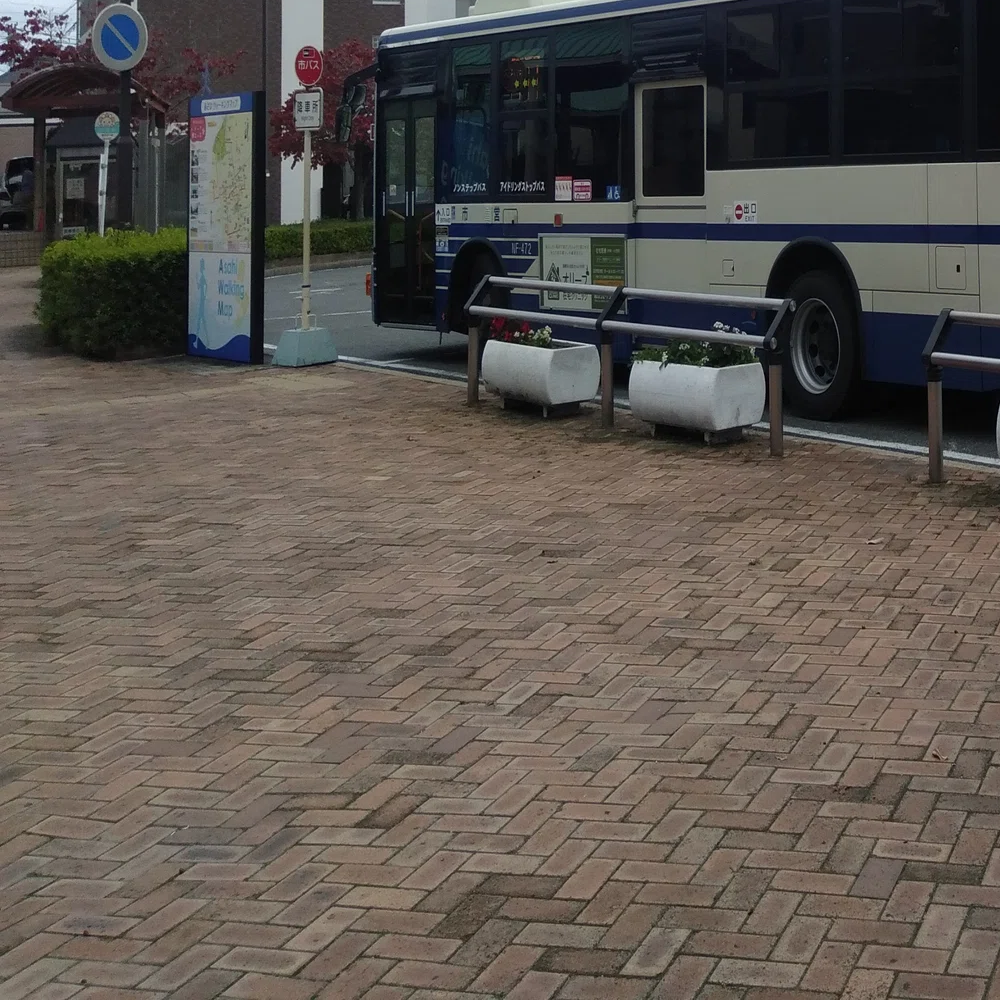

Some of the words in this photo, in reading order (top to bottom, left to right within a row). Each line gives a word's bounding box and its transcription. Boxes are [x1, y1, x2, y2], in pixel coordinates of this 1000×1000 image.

[298, 60, 319, 70] 市バス
[453, 182, 486, 192] ノンステップバス
[500, 181, 545, 192] アイドリングストップバス
[440, 207, 450, 217] 入口
[743, 203, 756, 214] 出口
[511, 242, 532, 254] NF-472
[218, 258, 238, 275] Asahi
[217, 279, 245, 300] Walking
[217, 301, 234, 319] Map
